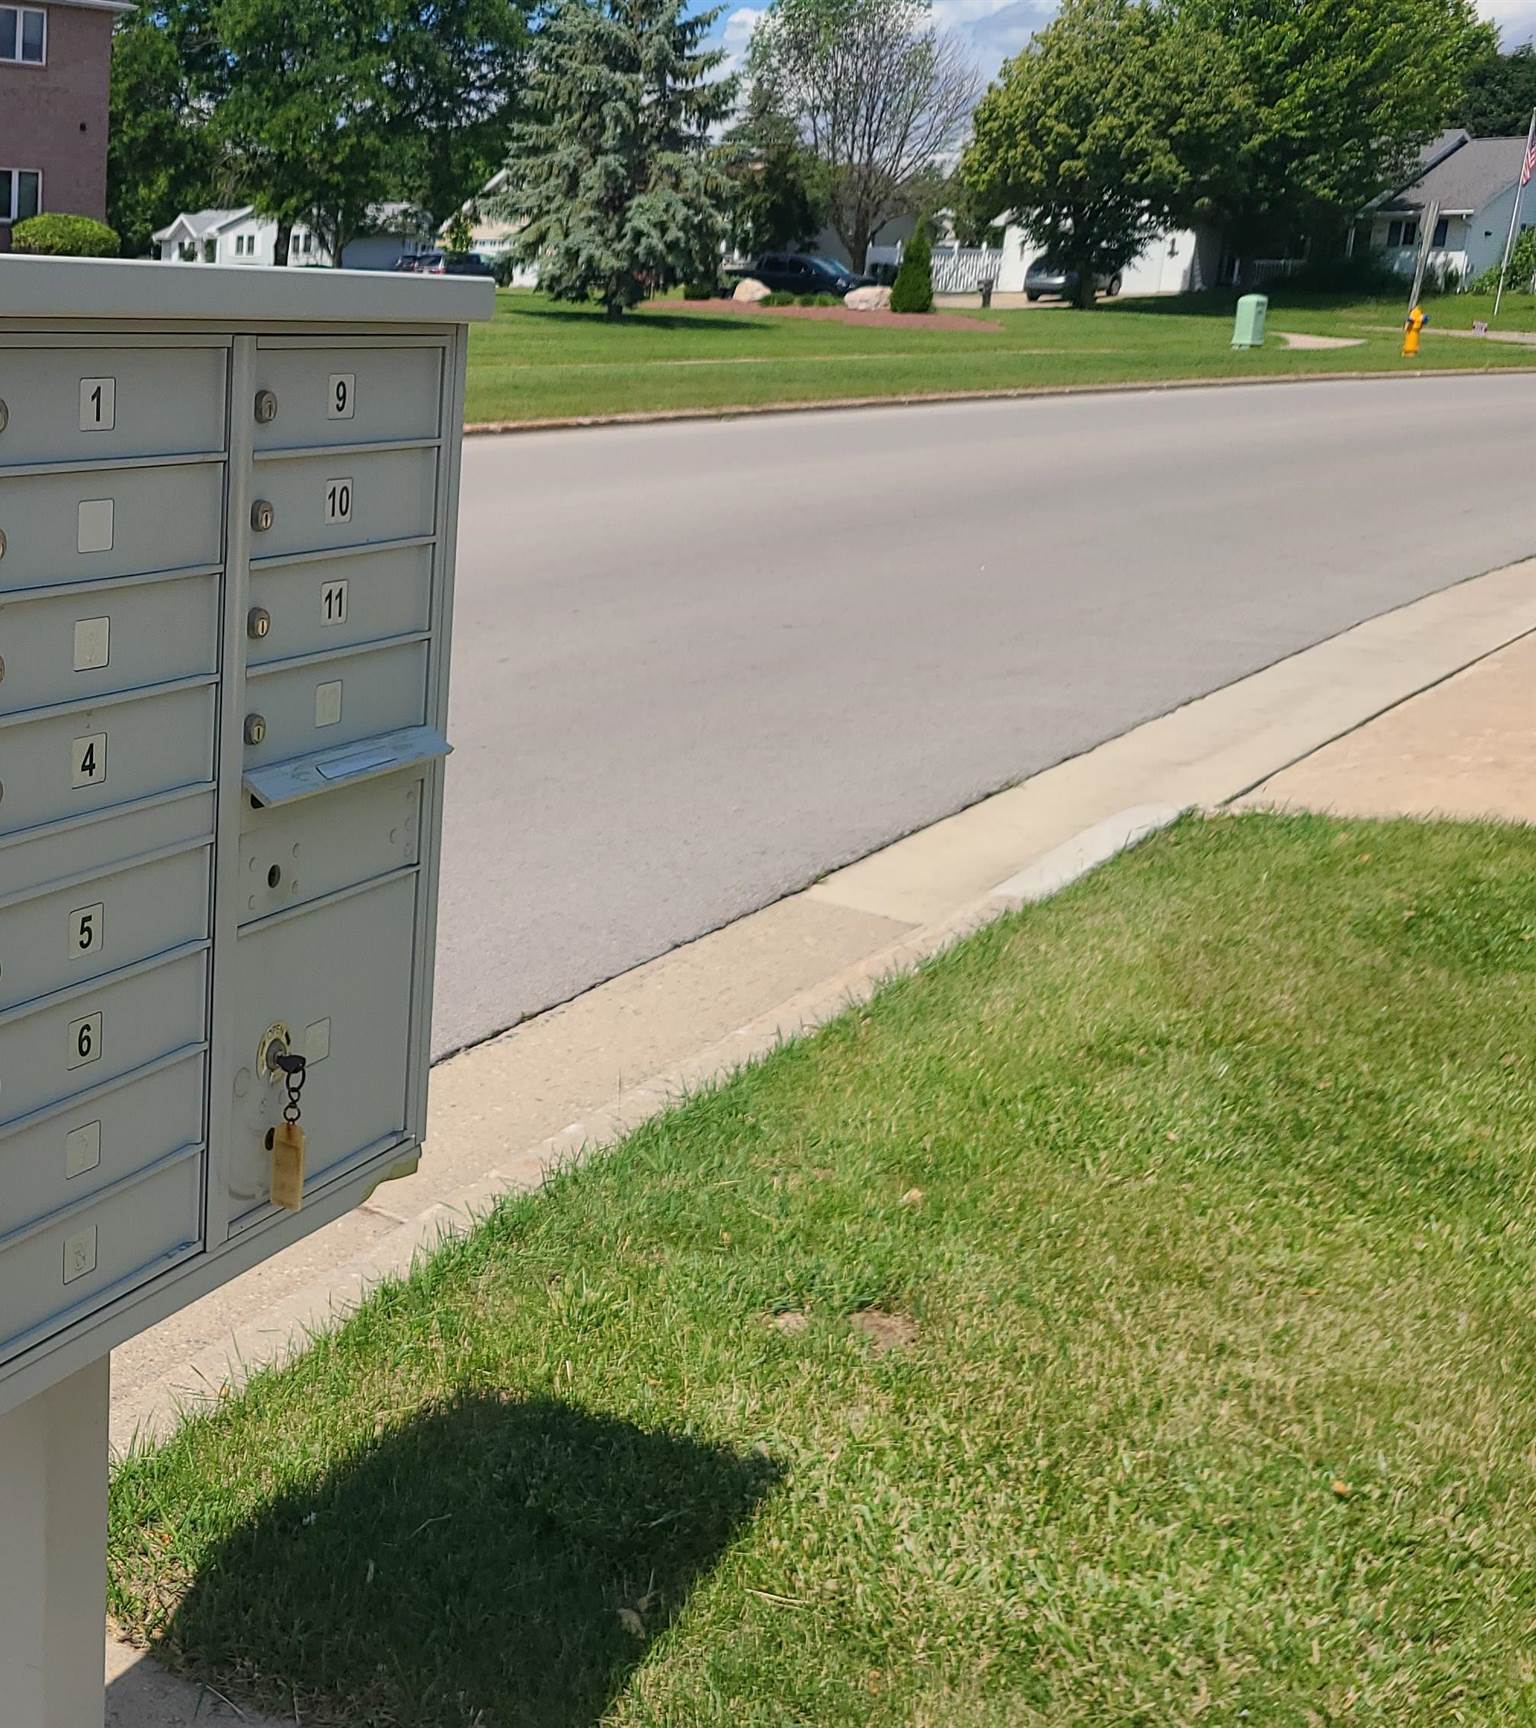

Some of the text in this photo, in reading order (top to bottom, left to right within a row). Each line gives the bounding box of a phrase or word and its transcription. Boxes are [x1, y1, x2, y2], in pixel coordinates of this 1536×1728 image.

[90, 386, 102, 422] 1
[335, 380, 347, 412] 9
[327, 485, 350, 517] 10
[324, 588, 344, 619] 11
[81, 743, 96, 777] 4
[79, 915, 93, 950] 5
[77, 1023, 91, 1058] 6
